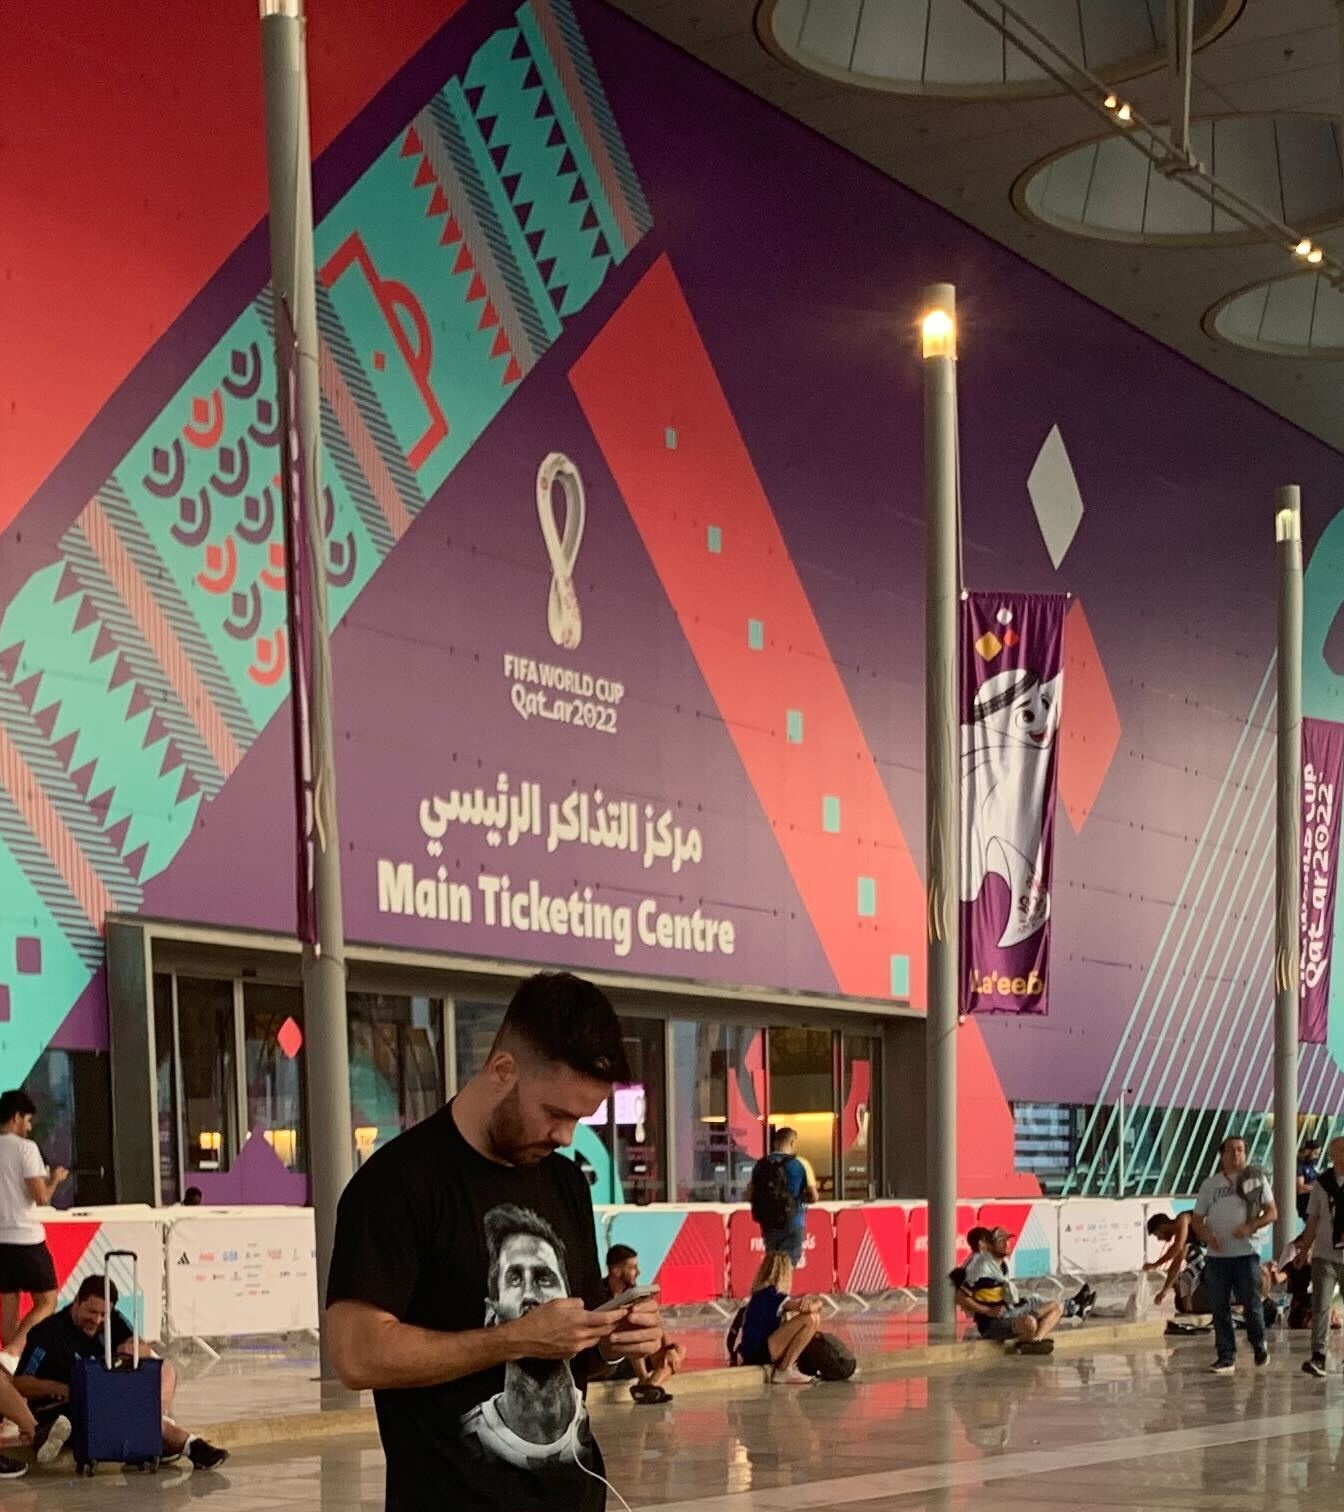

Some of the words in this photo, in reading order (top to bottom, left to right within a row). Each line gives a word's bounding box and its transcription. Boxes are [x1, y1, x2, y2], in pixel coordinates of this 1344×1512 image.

[503, 653, 539, 684] FIFA
[538, 661, 593, 697] WORLD
[596, 676, 625, 704] CUP
[510, 681, 618, 734] Qatar2022
[419, 772, 542, 857] الرئيسي
[547, 788, 639, 853] التذاكر
[644, 804, 702, 872] مركز
[377, 859, 472, 923] Main
[478, 873, 632, 956] Ticketing
[637, 899, 736, 954] Centre
[1304, 783, 1333, 988] Qatar2022
